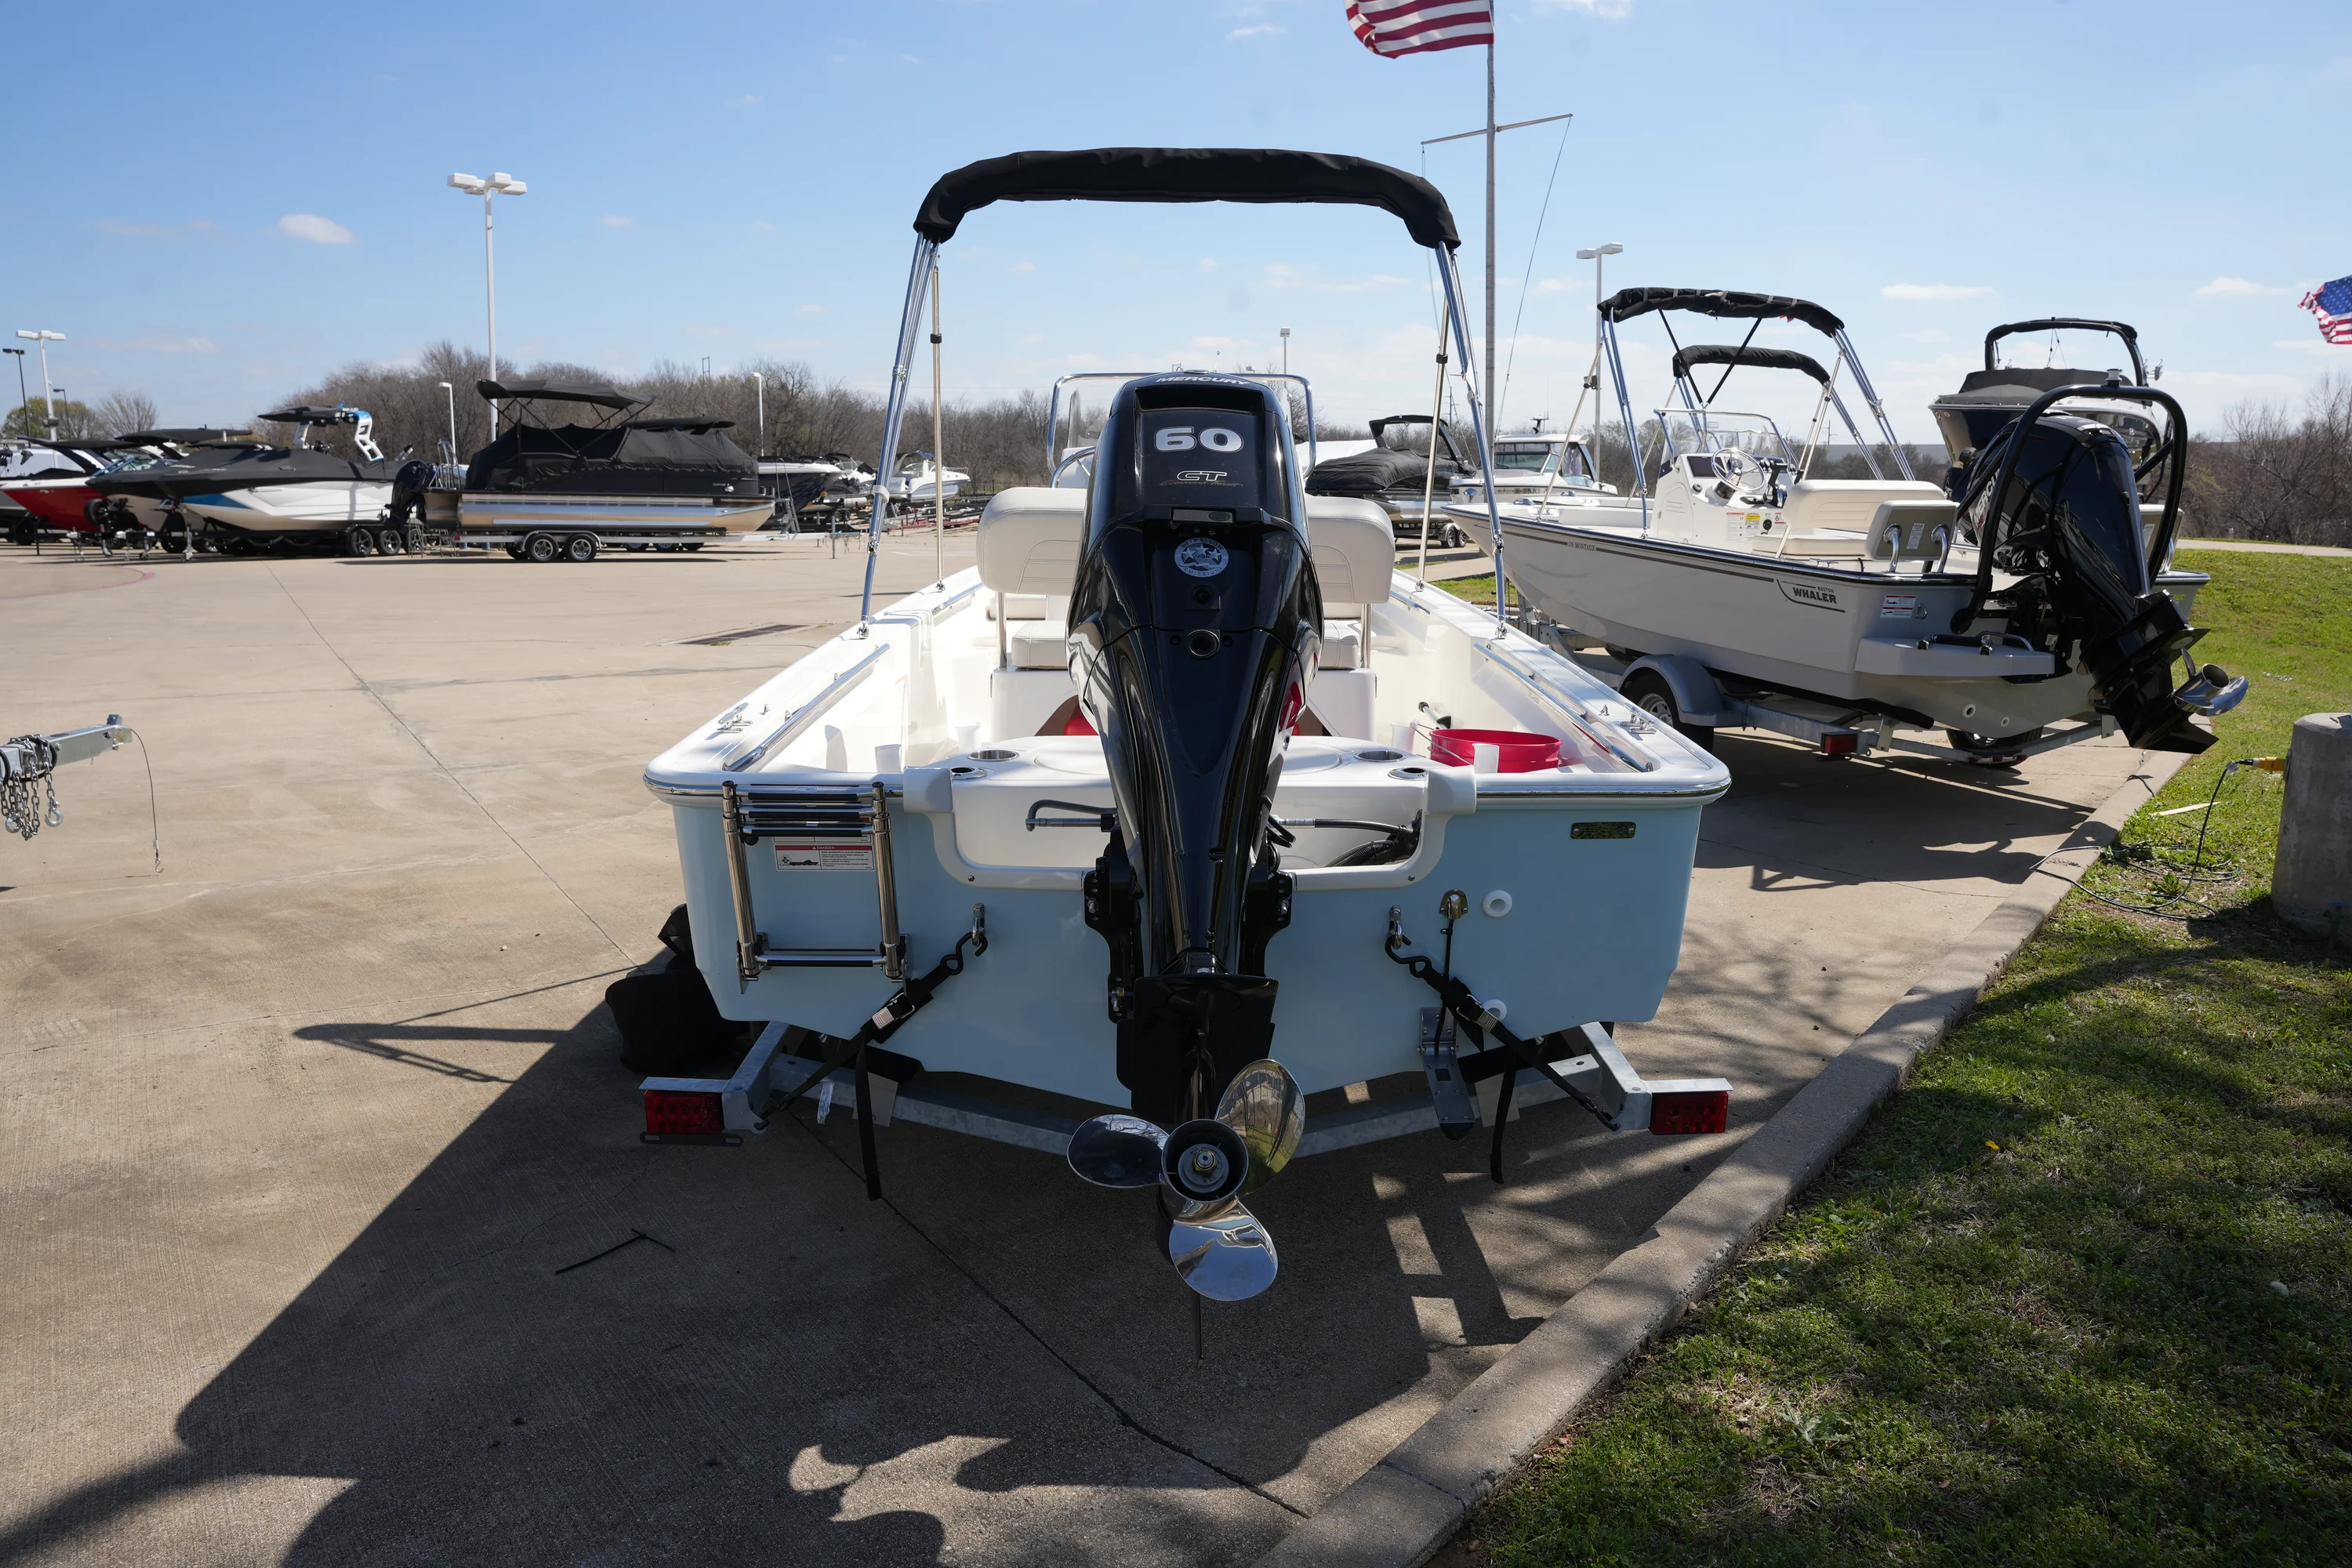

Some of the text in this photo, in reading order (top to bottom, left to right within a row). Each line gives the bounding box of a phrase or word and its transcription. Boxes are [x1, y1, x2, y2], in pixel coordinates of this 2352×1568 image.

[1156, 376, 1250, 385] MERCURY
[1154, 426, 1244, 452] 60
[1973, 468, 2000, 528] MERCU
[1209, 539, 1224, 550] LOW
[1792, 587, 1837, 604] WHALER
